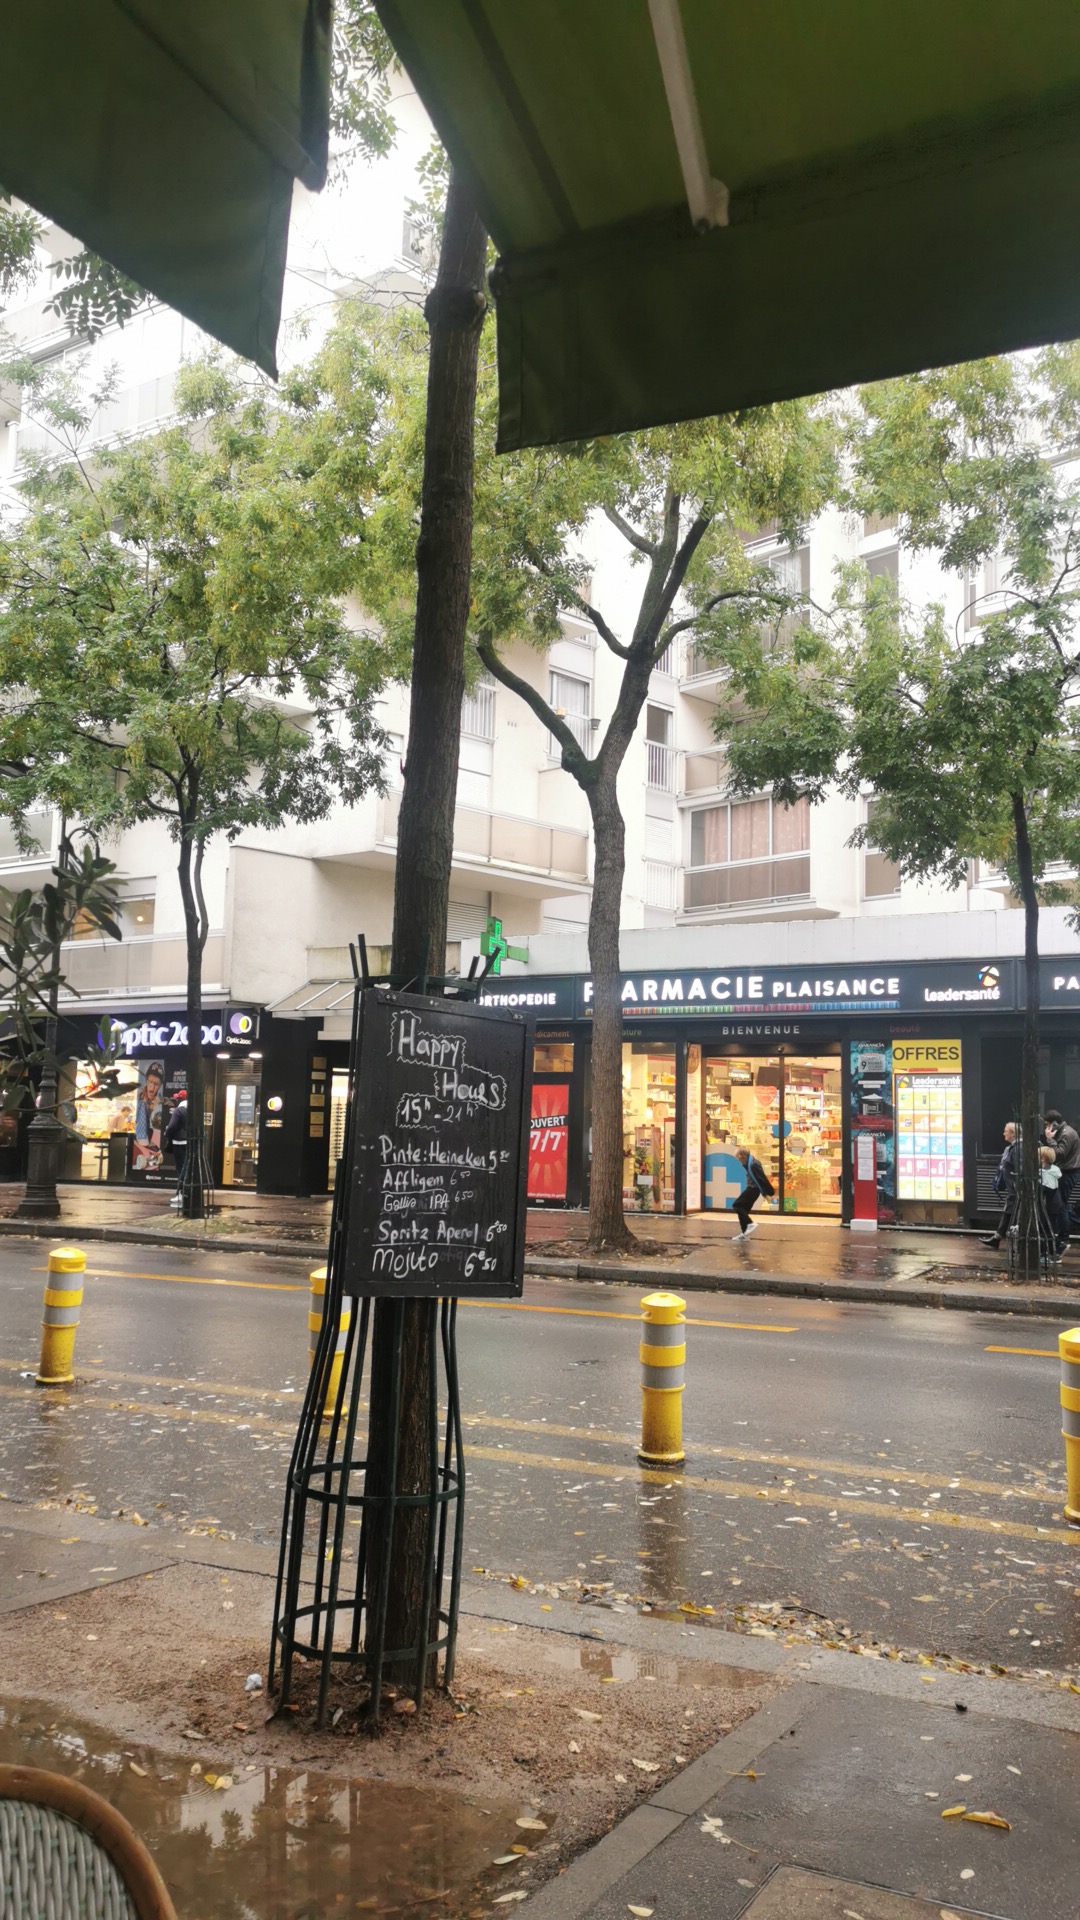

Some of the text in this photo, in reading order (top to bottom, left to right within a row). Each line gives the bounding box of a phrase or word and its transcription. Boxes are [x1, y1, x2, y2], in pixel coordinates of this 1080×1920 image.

[584, 976, 900, 1003] PARMACIE PLAISANCE
[924, 986, 1000, 1002] Leadersanté
[535, 1030, 570, 1038] dicament
[722, 1025, 800, 1035] BIENVENUE
[889, 1024, 920, 1034] beauté
[398, 1018, 460, 1067] Happy
[892, 1046, 959, 1061] OFFRES
[442, 1071, 500, 1107] Hours
[912, 1075, 960, 1085] Leadersanté
[428, 1140, 487, 1168] Heineken
[382, 1168, 444, 1192] Affligem
[429, 1191, 450, 1210] IPA
[378, 1219, 429, 1246] Spritz
[436, 1219, 479, 1245] Aperol
[372, 1245, 439, 1279] Mojito
